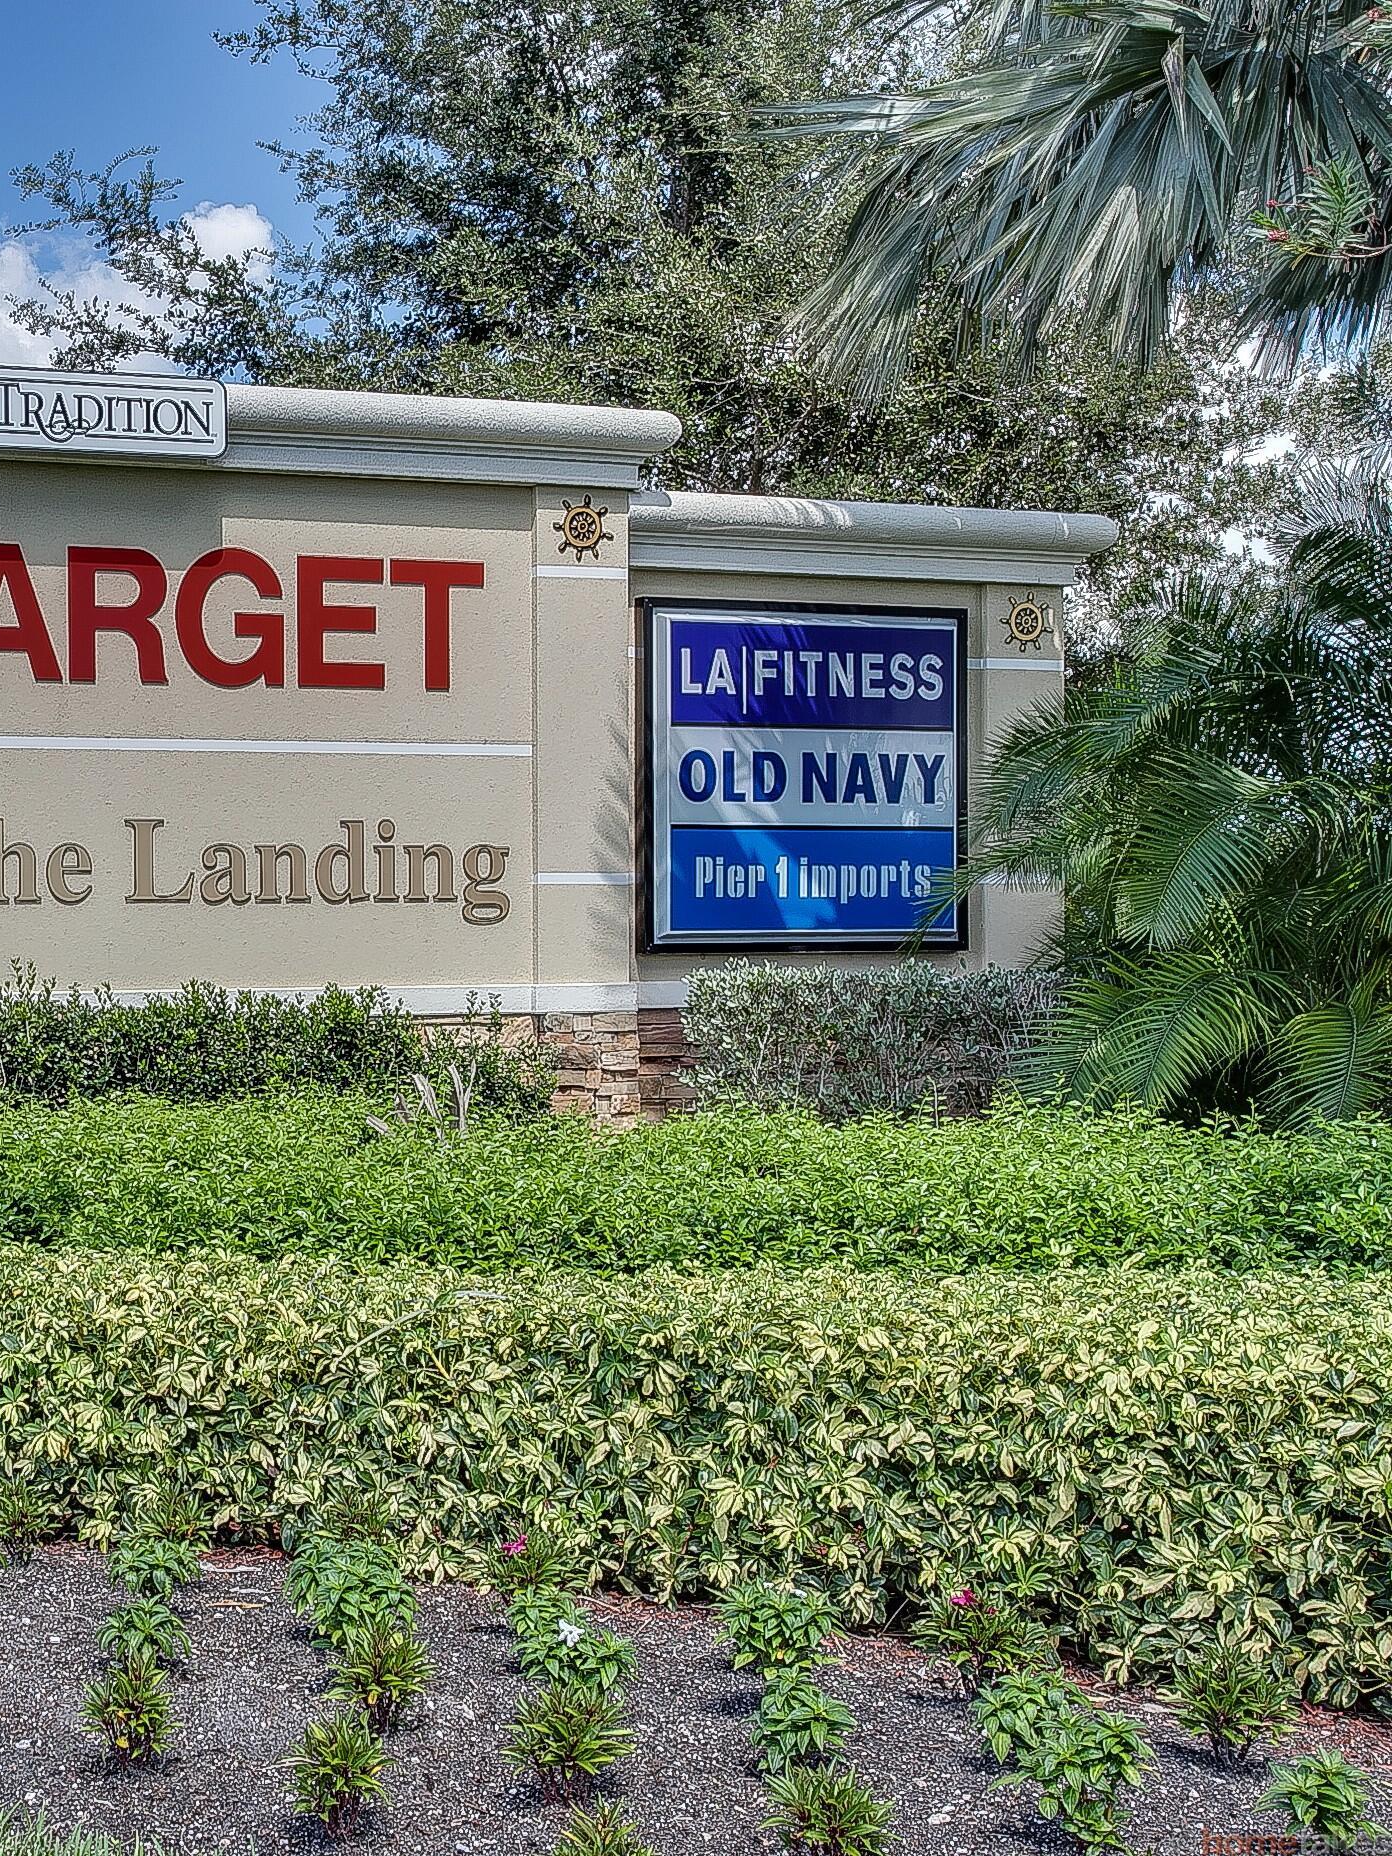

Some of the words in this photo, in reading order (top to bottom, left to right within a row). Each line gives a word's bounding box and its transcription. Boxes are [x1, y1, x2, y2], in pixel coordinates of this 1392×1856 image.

[678, 749, 788, 803] OLD
[801, 751, 946, 805] NAVY
[125, 818, 512, 926] Landing
[695, 856, 765, 898] Pier
[775, 856, 788, 898] 1
[799, 856, 932, 904] imports
